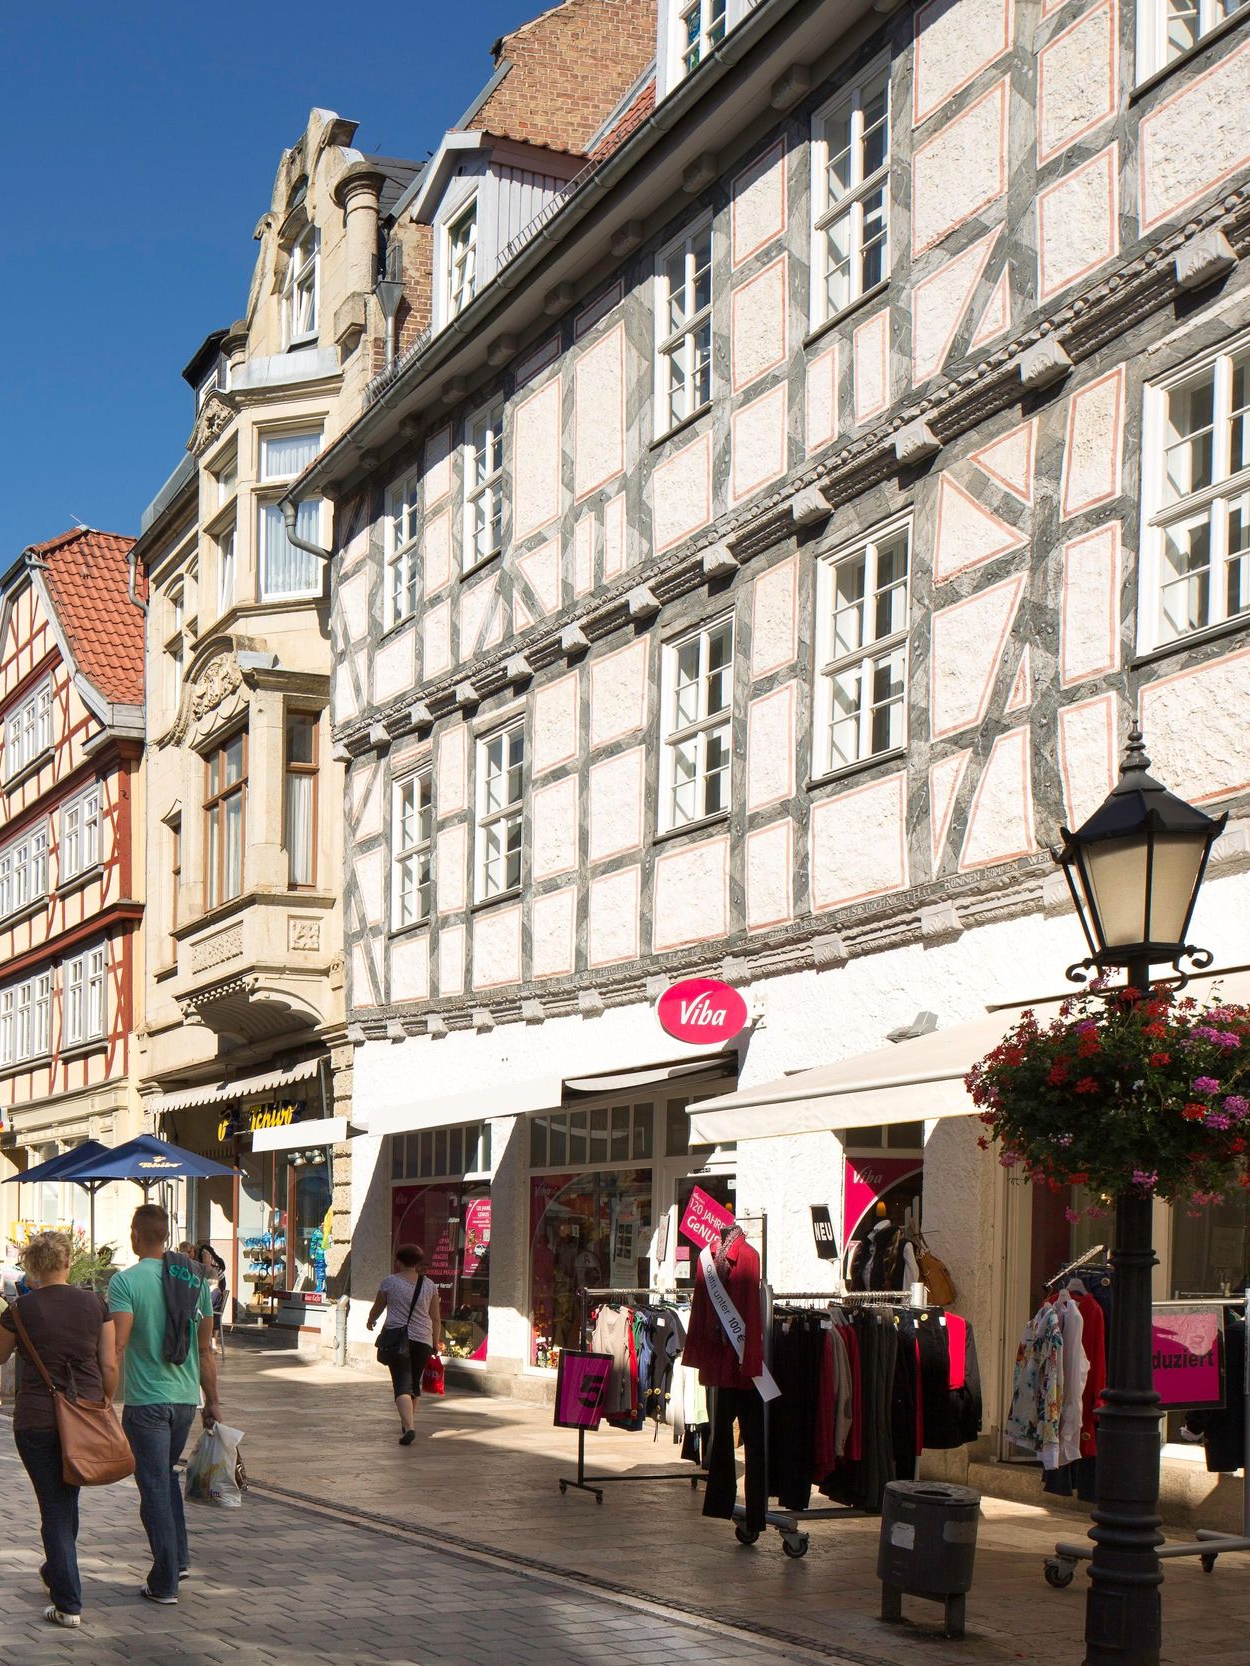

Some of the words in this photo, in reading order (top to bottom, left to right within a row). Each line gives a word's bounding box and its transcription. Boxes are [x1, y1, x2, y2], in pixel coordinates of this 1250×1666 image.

[680, 991, 727, 1026] Viba
[853, 1165, 884, 1184] Viba
[689, 1198, 704, 1215] 120
[813, 1222, 834, 1241] NEU
[705, 1264, 717, 1290] Outfit
[713, 1289, 731, 1315] unter
[728, 1316, 742, 1335] 100
[1152, 1349, 1214, 1370] duziert
[578, 1374, 605, 1408] 5
